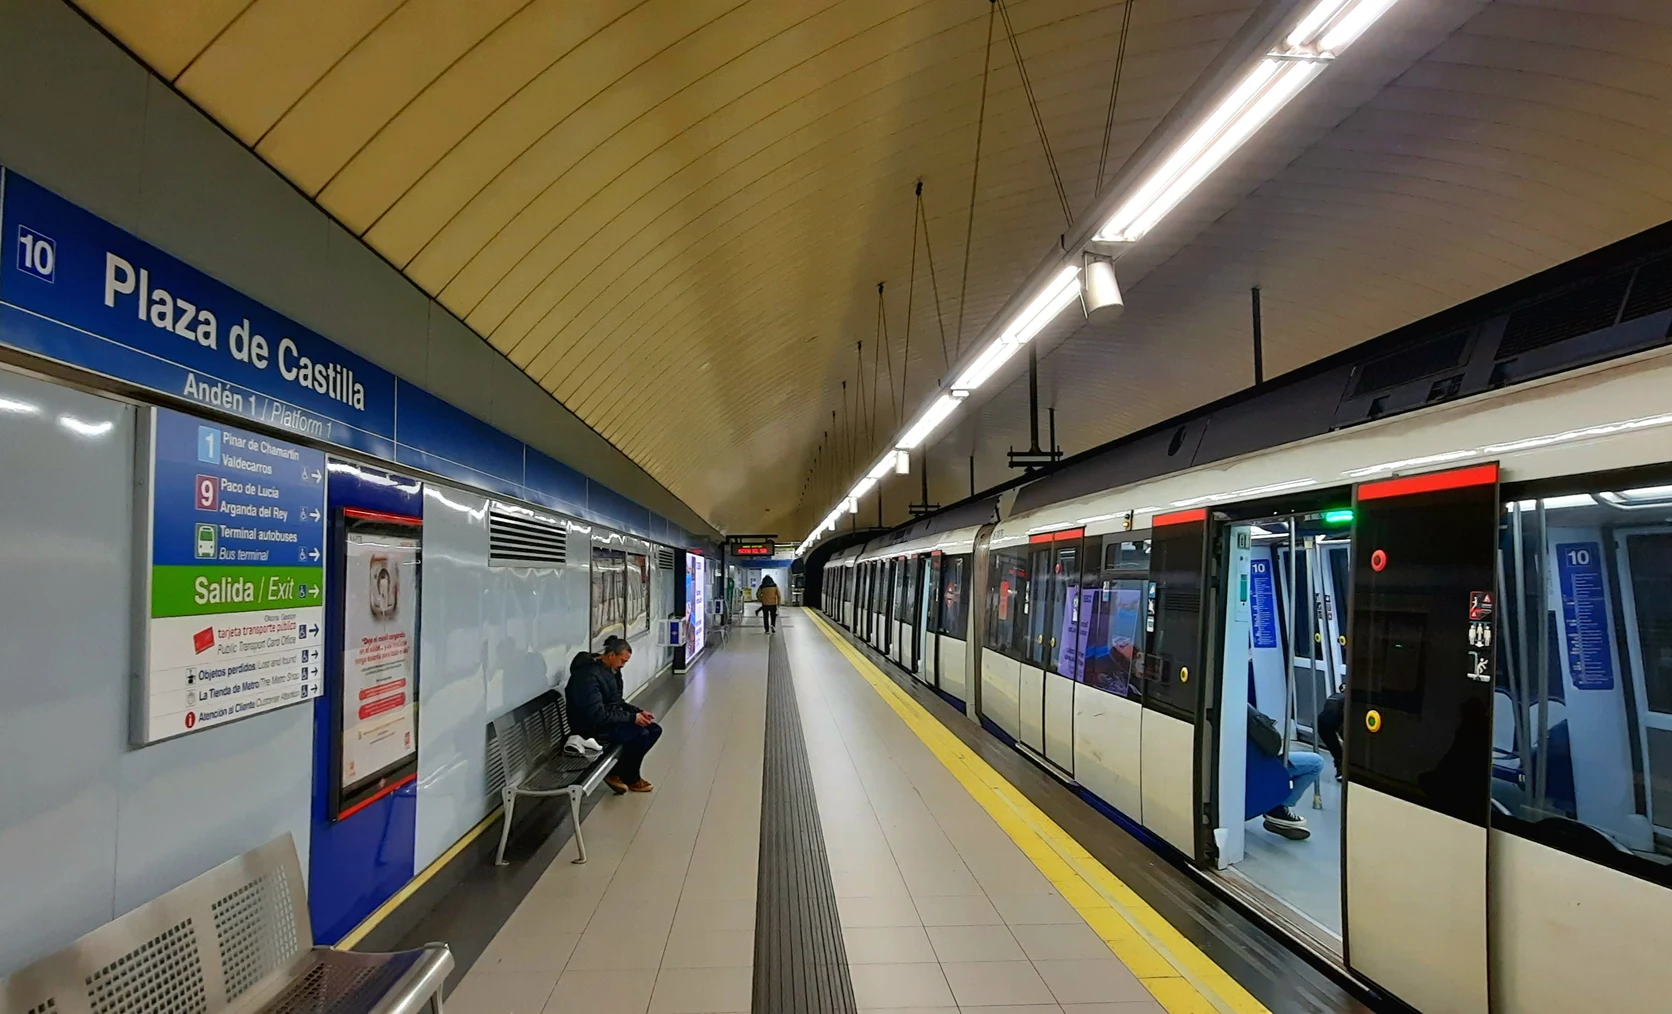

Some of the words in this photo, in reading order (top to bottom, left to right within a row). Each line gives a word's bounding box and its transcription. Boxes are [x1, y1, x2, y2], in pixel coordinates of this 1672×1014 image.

[20, 234, 54, 276] 10
[104, 251, 217, 350] Plaza
[229, 319, 268, 369] de
[278, 338, 365, 411] Castilla
[183, 372, 243, 412] Andén
[249, 395, 256, 416] 1
[270, 402, 322, 436] Platform
[325, 421, 332, 438] 1
[205, 432, 214, 458] 1
[222, 431, 247, 449] Pinar
[248, 440, 258, 451] de
[222, 454, 272, 475] Valdecarros
[201, 480, 214, 506] 9
[220, 478, 243, 493] Paco
[245, 483, 256, 495] de
[220, 501, 257, 517] Arganda
[259, 504, 271, 518] del
[273, 507, 288, 522] Rey
[220, 525, 257, 540] Terminal
[258, 529, 298, 542] autobuses
[219, 547, 236, 560] Bus
[238, 550, 269, 561] terminal
[1568, 550, 1590, 565] 10
[1252, 563, 1265, 573] 10
[194, 576, 254, 605] Salida
[267, 576, 295, 600] Exit
[217, 627, 242, 639] tarjeta
[243, 624, 276, 636] transporte
[217, 643, 238, 655] Public
[239, 640, 266, 652] Transport
[266, 637, 280, 648] Card
[280, 635, 297, 645] Office
[198, 668, 227, 681] Objetos
[227, 663, 256, 677] perdidos
[199, 691, 208, 701] La
[209, 686, 232, 698] Tienda
[232, 684, 241, 694] de
[242, 681, 260, 692] Metro
[228, 705, 235, 715] al
[235, 700, 256, 713] Cliente
